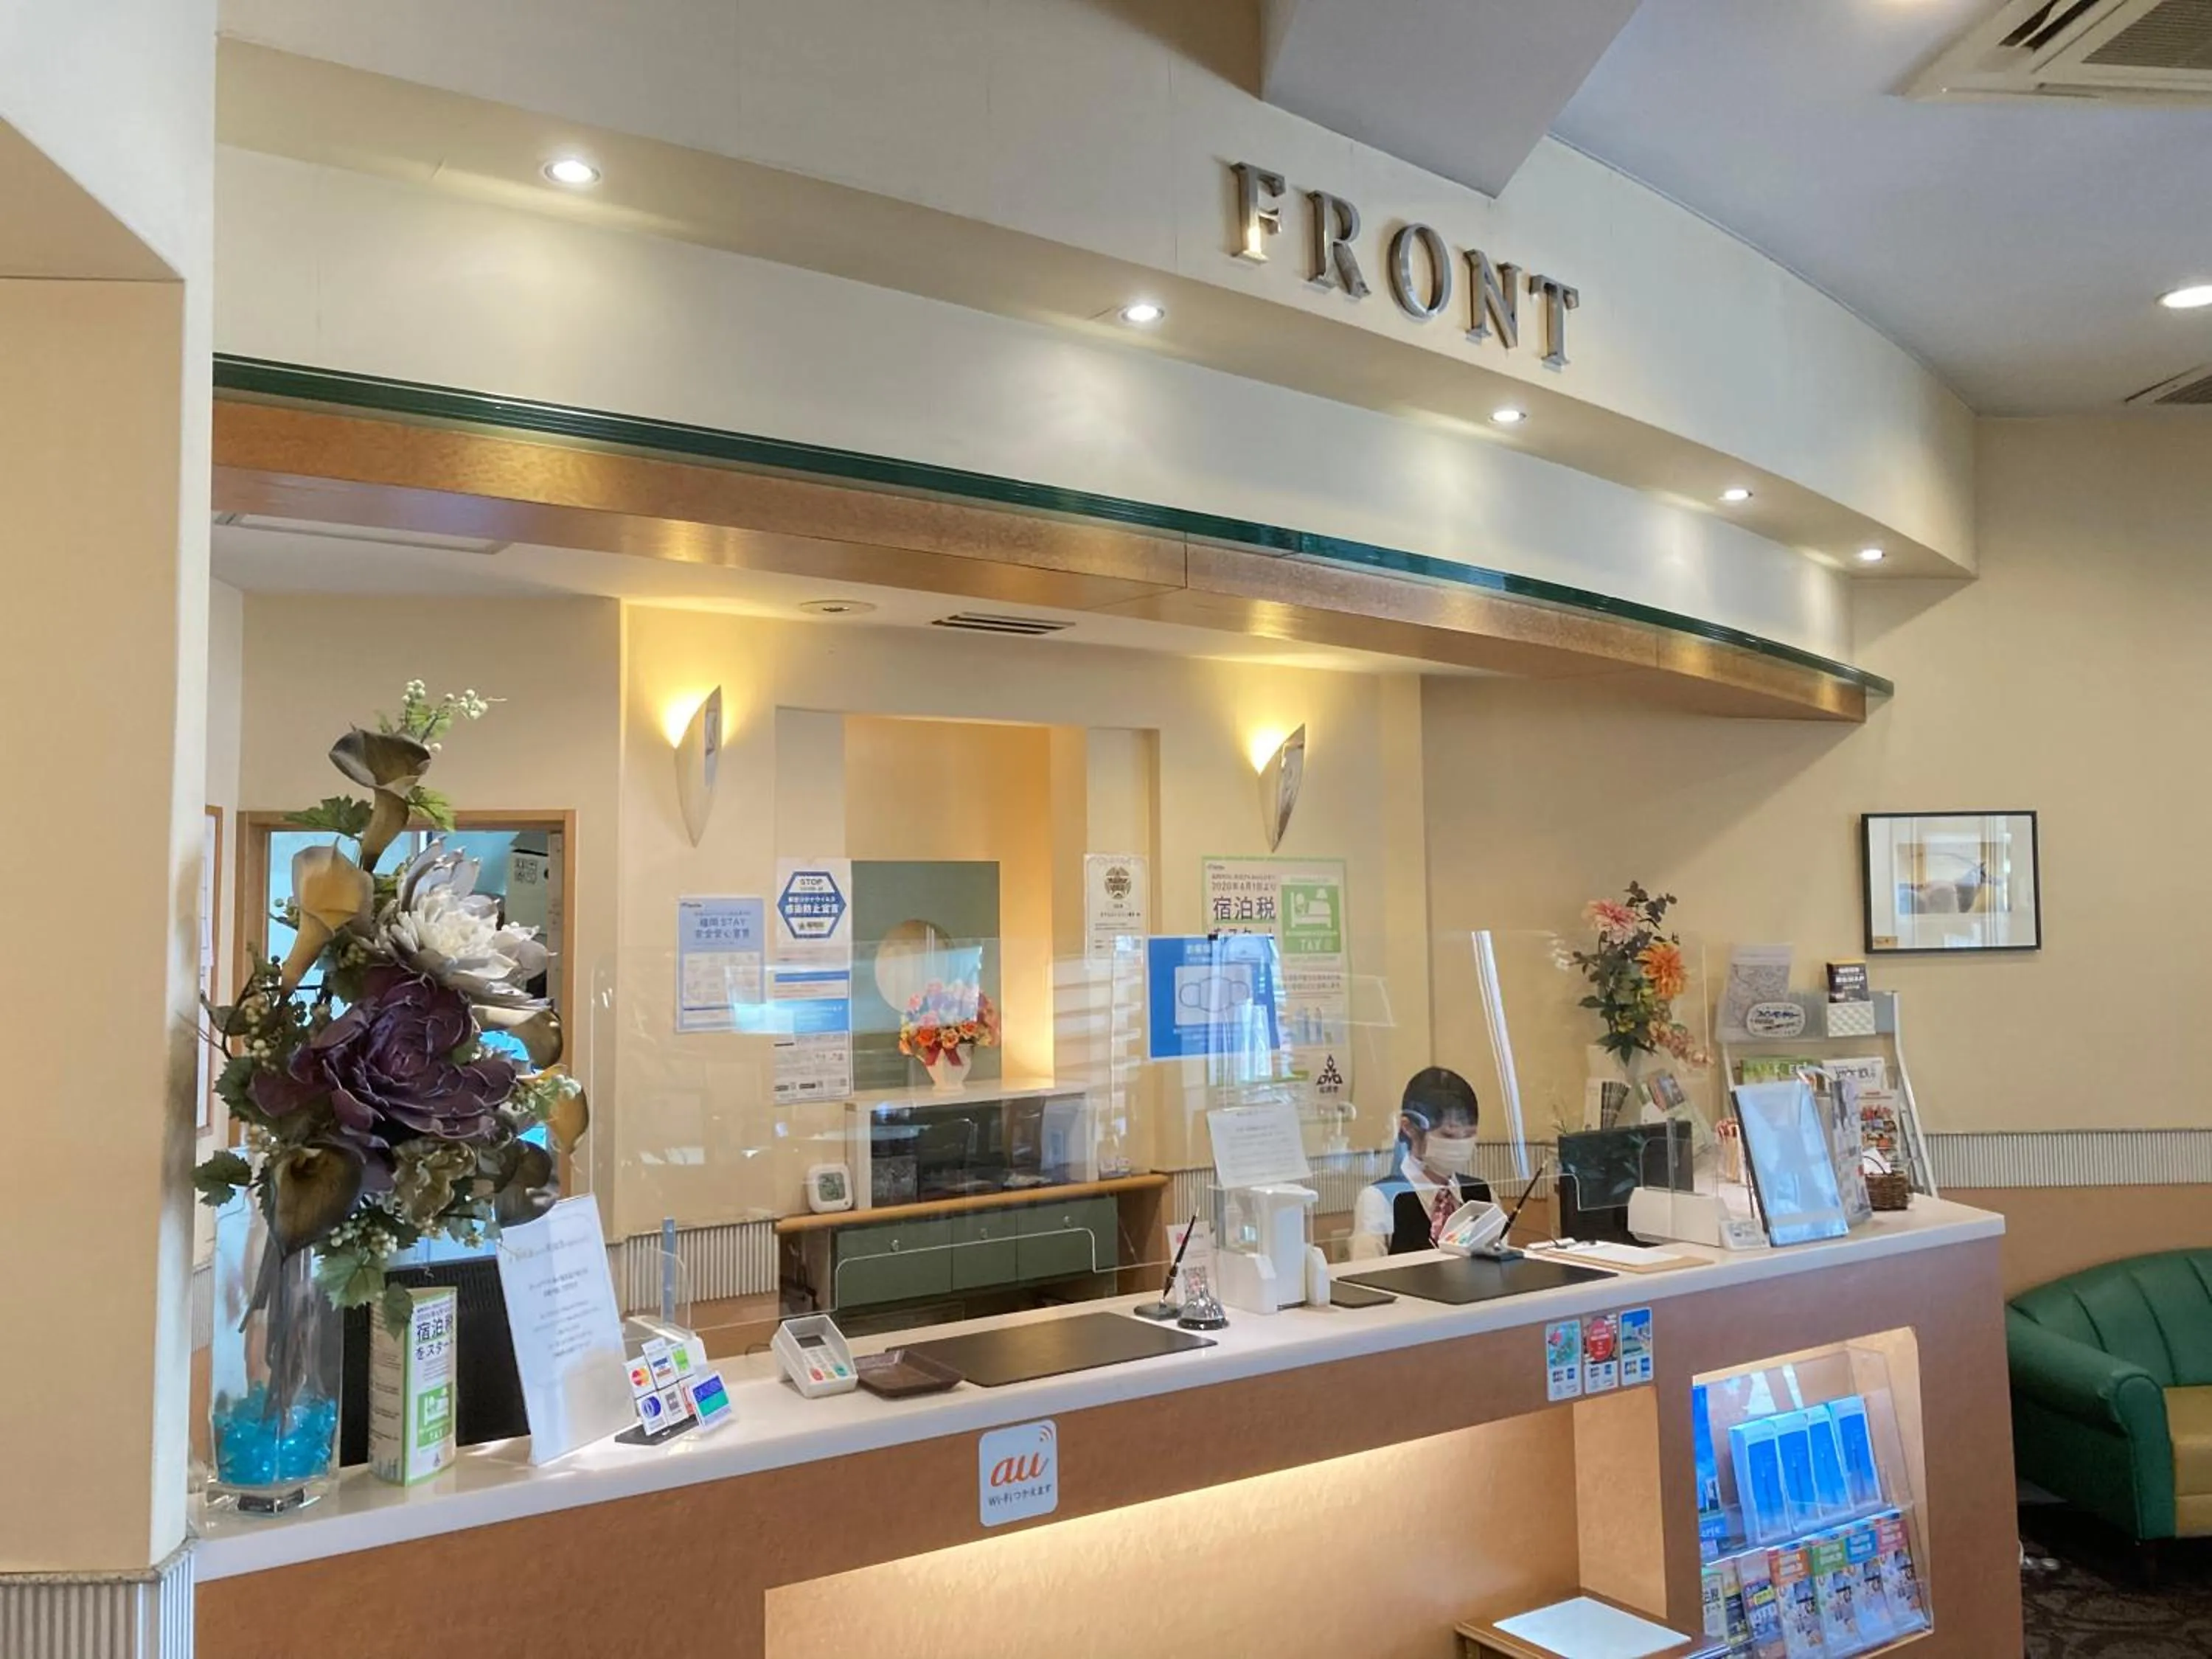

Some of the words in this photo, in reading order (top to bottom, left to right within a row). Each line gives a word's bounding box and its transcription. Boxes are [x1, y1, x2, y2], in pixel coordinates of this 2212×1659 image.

[1231, 161, 1579, 370] FRONT
[1213, 896, 1276, 921] 宿泊税
[990, 1451, 1050, 1487] au
